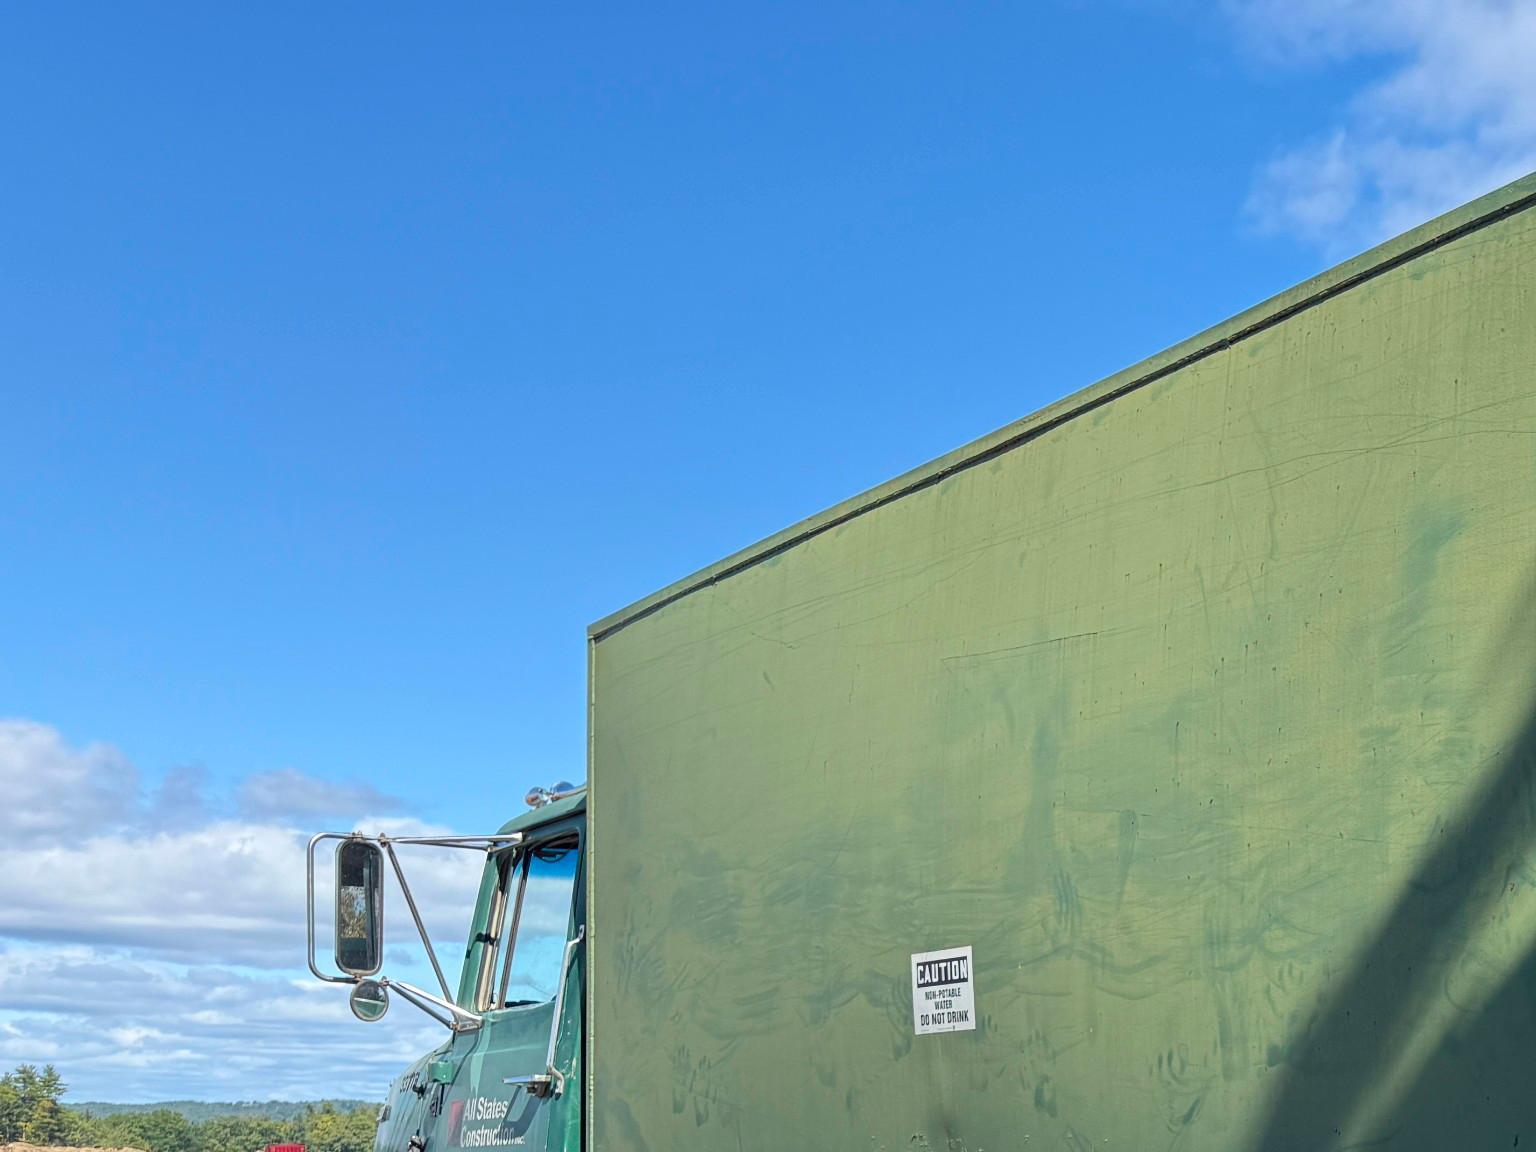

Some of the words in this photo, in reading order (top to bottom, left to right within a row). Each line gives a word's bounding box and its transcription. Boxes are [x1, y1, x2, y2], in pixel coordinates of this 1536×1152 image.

[917, 959, 968, 985] CAUTION
[925, 988, 961, 1001] NON-POTABLE
[934, 1000, 953, 1010] WATER
[921, 1014, 930, 1026] DO
[932, 1012, 946, 1025] NOT
[947, 1009, 969, 1024] DRINK
[463, 1098, 478, 1121] All
[476, 1096, 509, 1120] States
